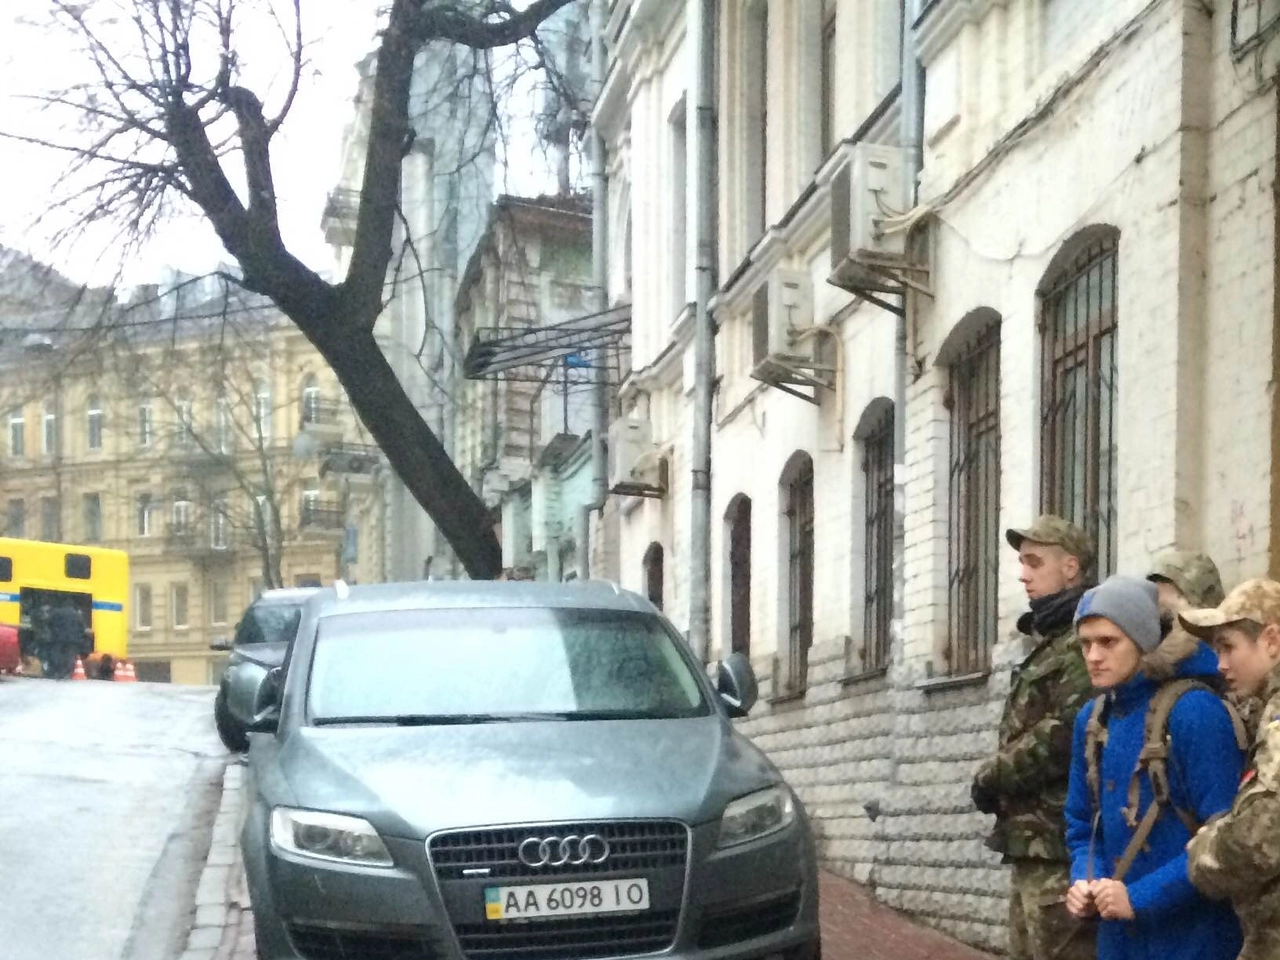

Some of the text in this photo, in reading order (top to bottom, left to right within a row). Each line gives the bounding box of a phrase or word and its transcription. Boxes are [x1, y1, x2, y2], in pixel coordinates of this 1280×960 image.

[504, 883, 643, 914] AA 6098 IO
